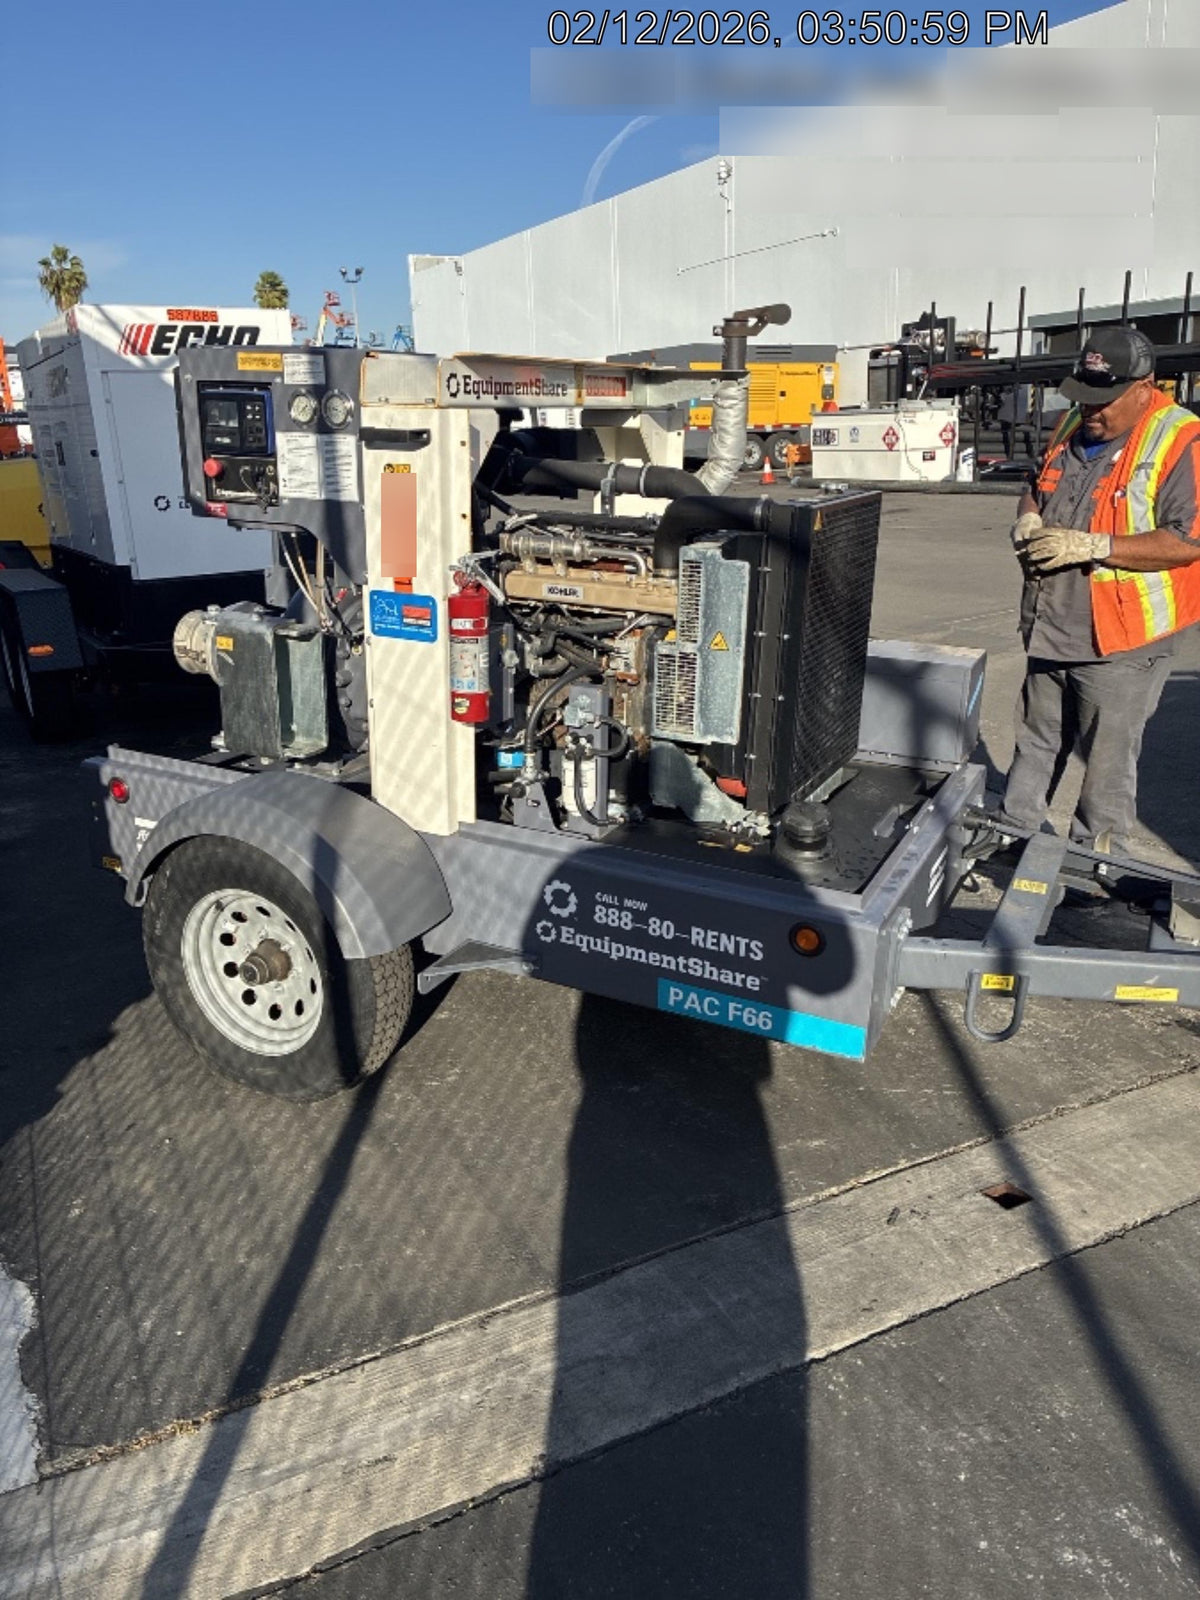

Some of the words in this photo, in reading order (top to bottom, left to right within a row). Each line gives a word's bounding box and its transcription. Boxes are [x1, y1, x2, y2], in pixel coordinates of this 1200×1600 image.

[151, 325, 260, 355] ECHO
[462, 374, 568, 400] EquipmentShare
[547, 586, 578, 597] KOHLER
[594, 892, 620, 905] CALL
[623, 898, 648, 911] NOW
[559, 925, 761, 991] EquipmentShare
[668, 986, 720, 1016] PAC
[728, 1002, 773, 1030] F66
